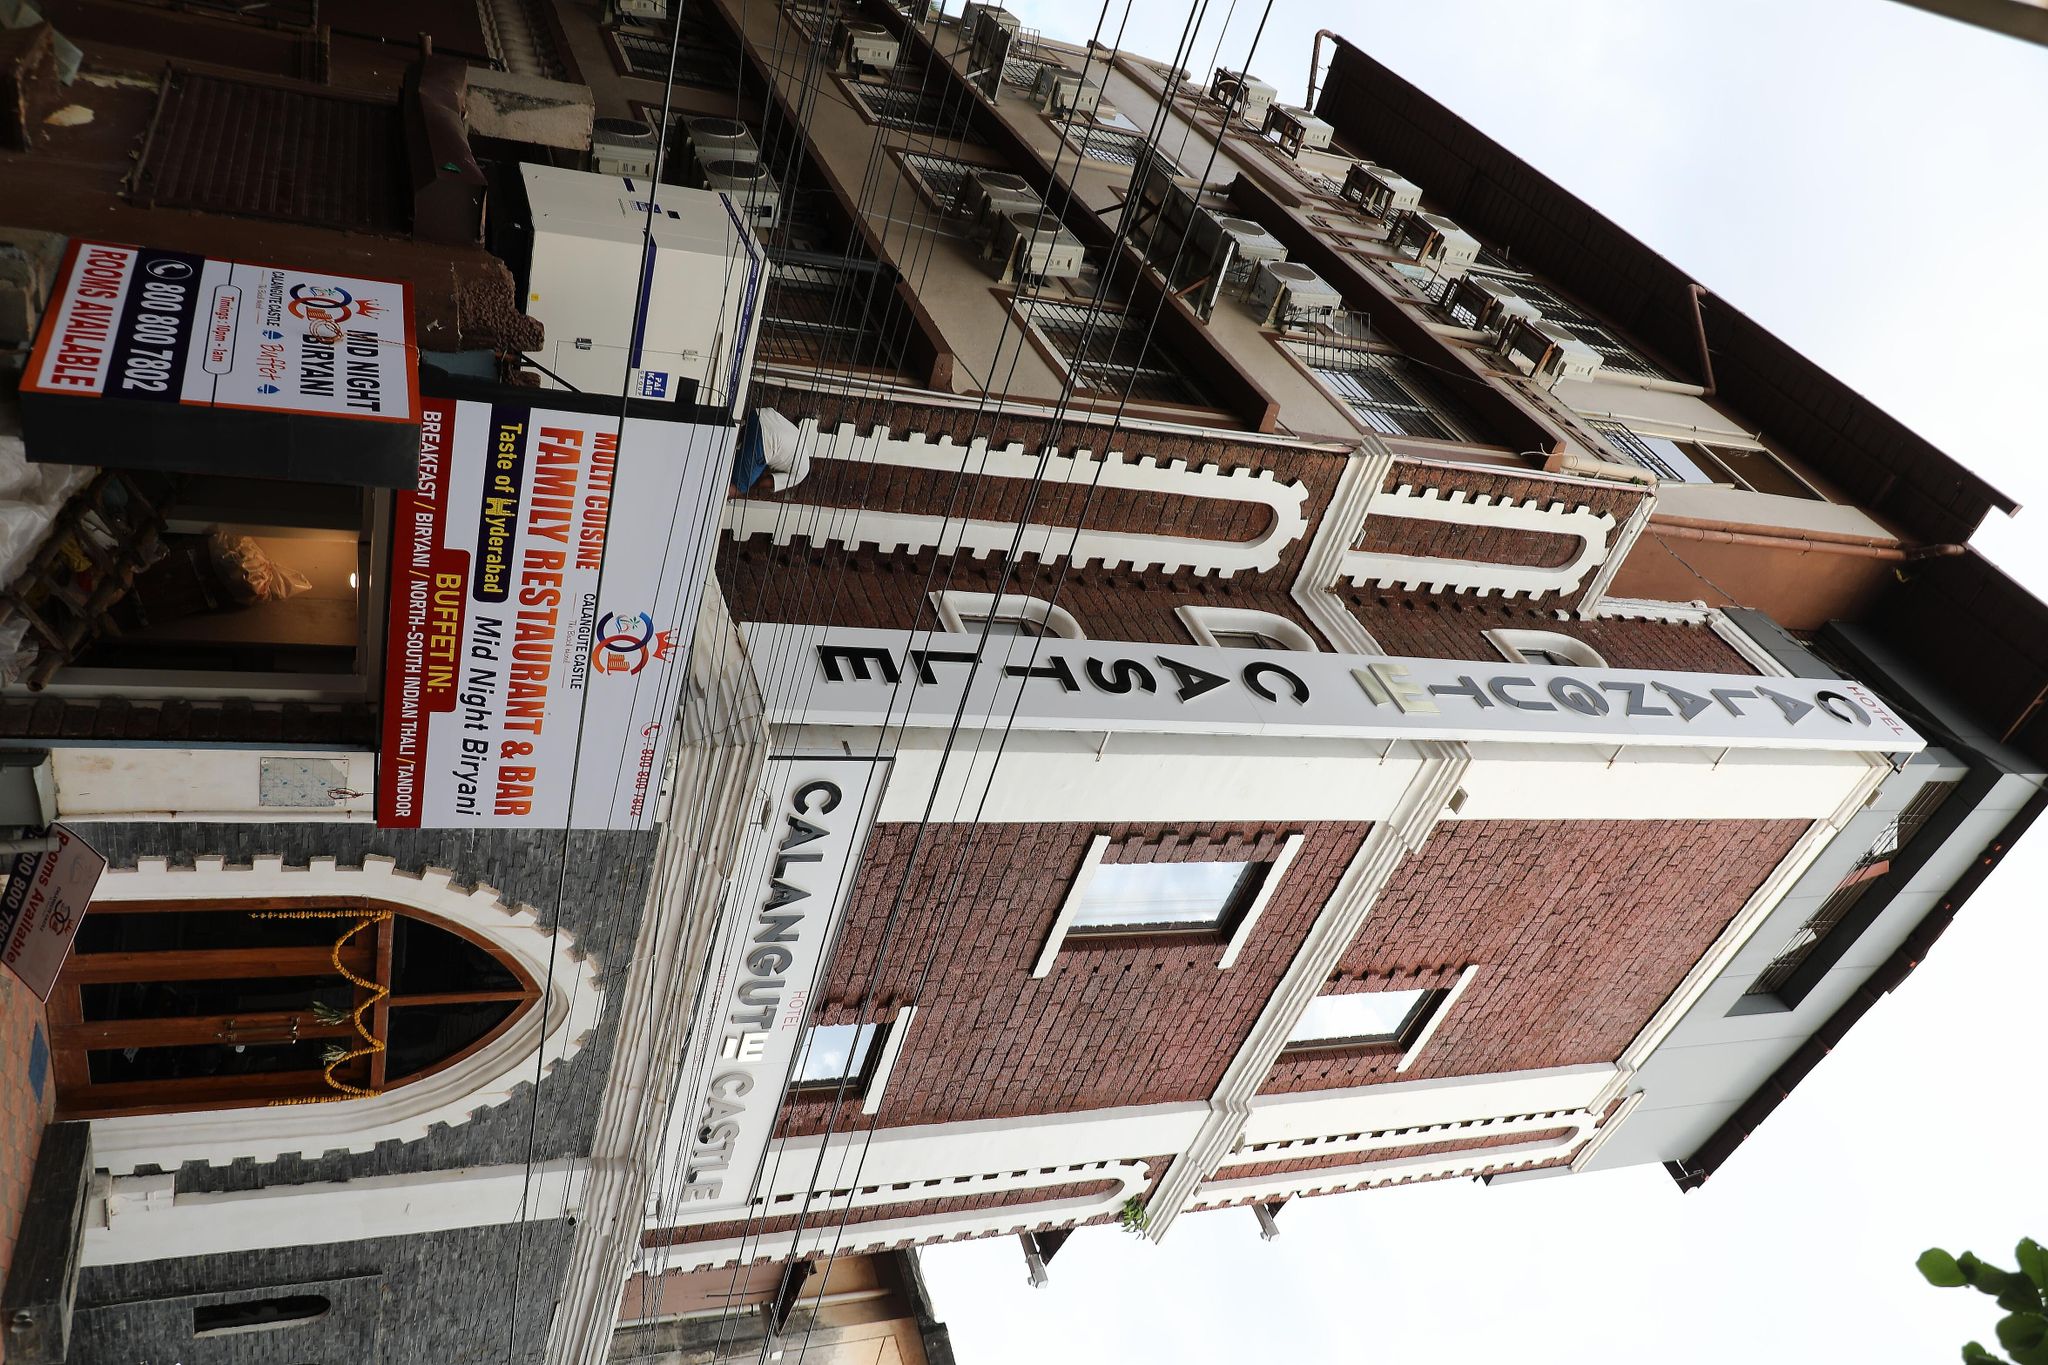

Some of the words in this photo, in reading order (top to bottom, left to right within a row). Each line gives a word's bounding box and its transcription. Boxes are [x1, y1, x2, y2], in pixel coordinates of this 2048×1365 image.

[77, 249, 129, 299] ROOMS
[140, 282, 186, 311] 800
[268, 271, 285, 304] CALANGUTE
[132, 314, 179, 344] 800
[215, 296, 234, 320] Timings
[266, 304, 282, 327] CASTLE
[51, 300, 114, 387] AVAILABLE
[212, 349, 227, 362] 1am
[213, 325, 230, 342] 10pm
[346, 329, 379, 357] MID
[122, 349, 173, 391] 7802
[256, 344, 286, 381] Buffet
[300, 334, 334, 397] BIRYANI
[346, 360, 381, 412] NIGHT
[417, 411, 442, 500] BREAKFAST
[497, 423, 523, 470] Taste
[587, 432, 618, 491] MULTI
[494, 475, 515, 493] of
[528, 427, 584, 544] FAMILY
[412, 512, 433, 568] BIRYANI
[576, 495, 610, 570] CUISINE
[404, 580, 428, 673] NORTH-SOUTH
[429, 573, 462, 662] BUFFET
[471, 616, 503, 661] Mid
[575, 593, 596, 652] CALANGUTE
[503, 549, 566, 735] RESTAURANT
[427, 665, 453, 693] IN:
[570, 654, 586, 690] CASTLE
[815, 645, 1310, 706] CASTLE
[1350, 663, 1872, 728] CALANGUTE
[401, 676, 421, 718] INDIAN
[459, 668, 497, 731] Night
[1846, 686, 1904, 736] HOTEL
[399, 721, 417, 755] THALI
[500, 741, 533, 759] &
[640, 749, 655, 767] 800
[452, 738, 488, 816] Biryani
[494, 766, 536, 816] BAR
[635, 771, 650, 789] 800
[630, 792, 645, 816] 7802
[18, 851, 39, 876] 00
[38, 831, 69, 887] Roms
[7, 876, 26, 909] 800
[5, 888, 44, 963] Available
[722, 779, 842, 1063] CALANGUTE
[781, 991, 808, 1031] HOTEL
[681, 1071, 755, 1203] CASTLE
